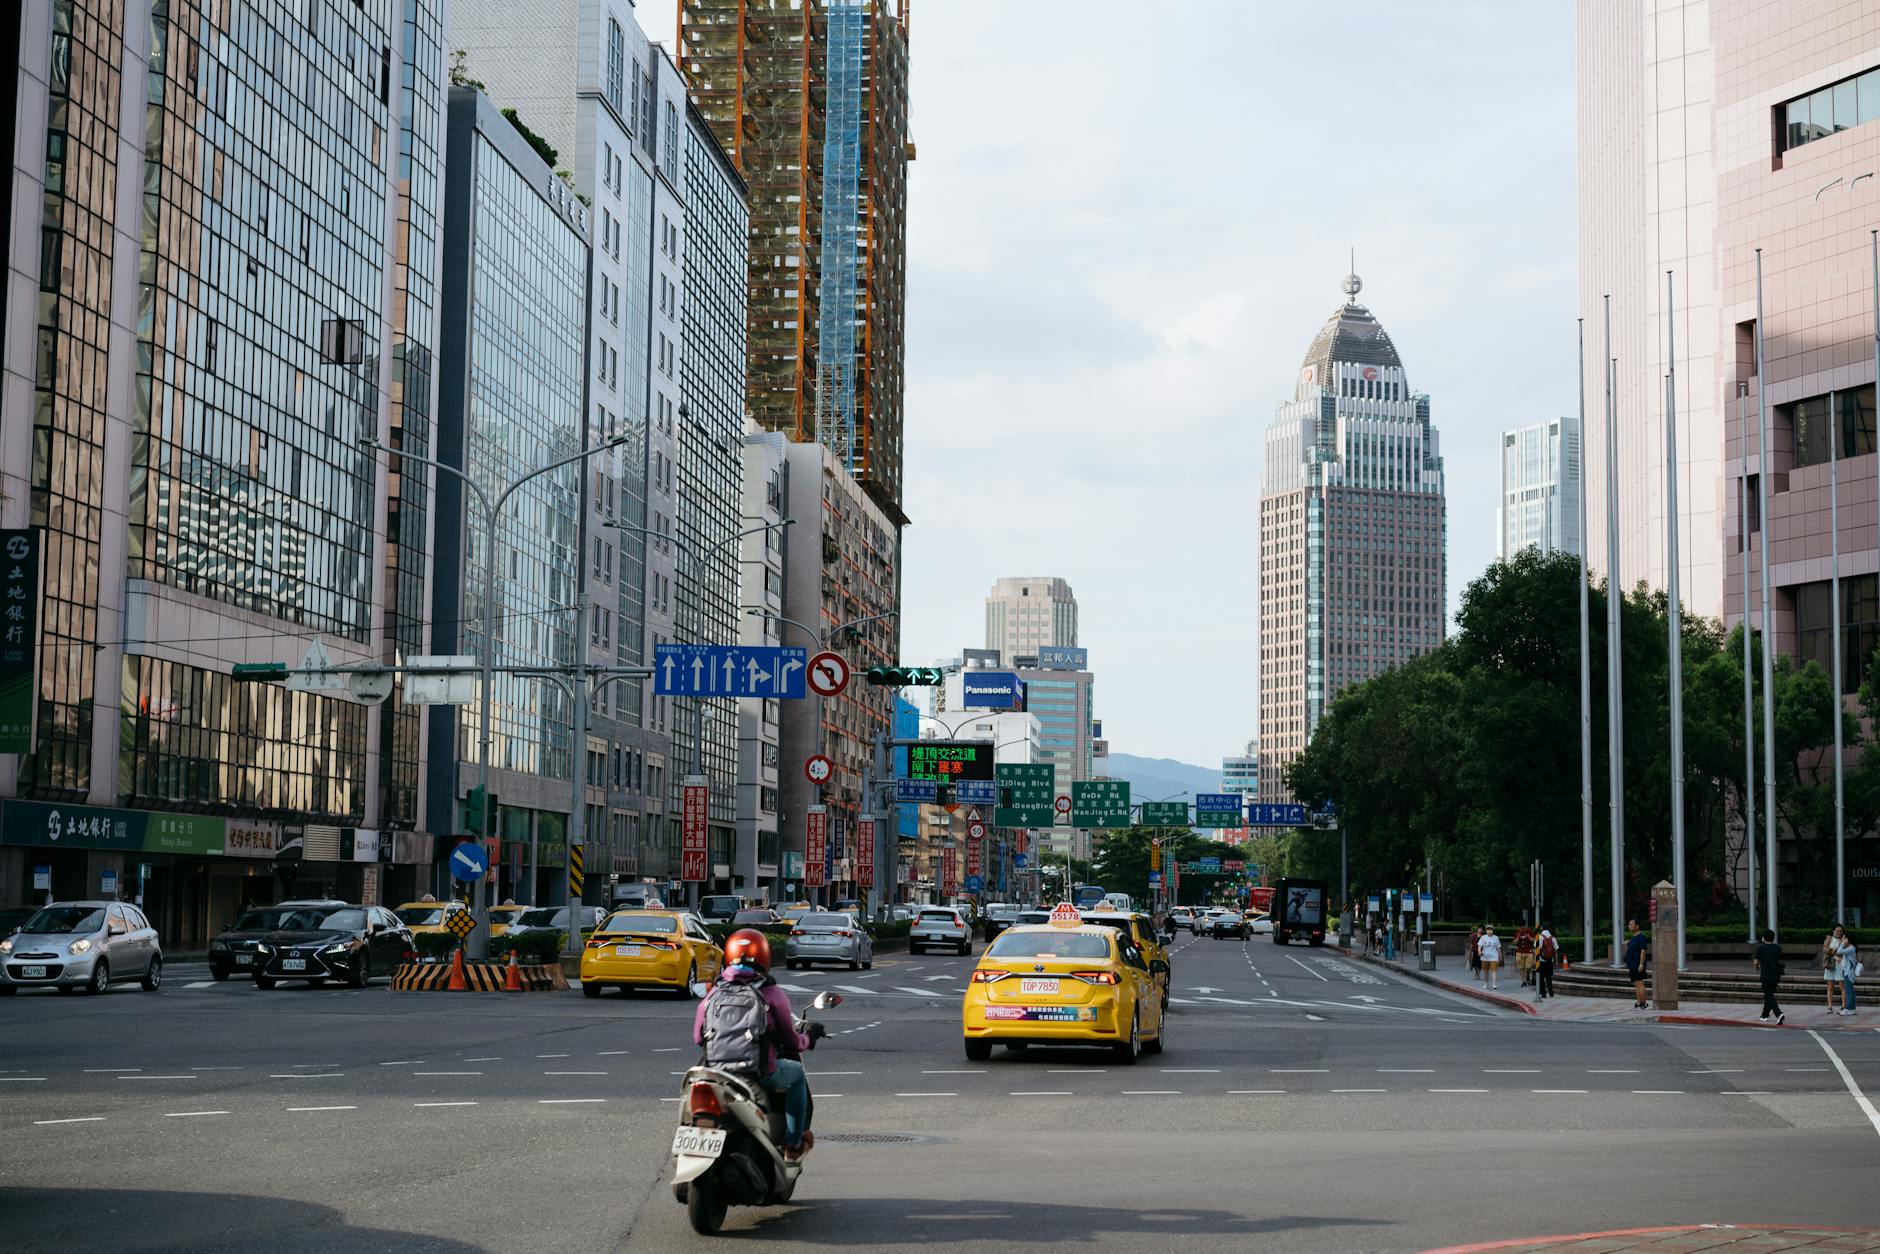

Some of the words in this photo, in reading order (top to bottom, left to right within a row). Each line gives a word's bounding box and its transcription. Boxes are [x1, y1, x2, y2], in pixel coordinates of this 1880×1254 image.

[5, 565, 26, 644] 土地銀行
[1043, 652, 1083, 664] 富邦人壽
[965, 686, 1011, 694] Panasonic
[912, 747, 976, 761] 堤頂交流道
[912, 761, 963, 773] 南下壅塞
[1001, 768, 1049, 777] 堤頂大道
[1084, 784, 1118, 792] 八德路
[1001, 790, 1049, 799] 東大道
[1076, 800, 1125, 808] 南京東路
[1198, 796, 1232, 804] 市政中心
[1073, 809, 1109, 817] NanJing
[66, 816, 111, 839] 土地銀行
[972, 827, 981, 835] 50
[1051, 912, 1079, 920] 55178
